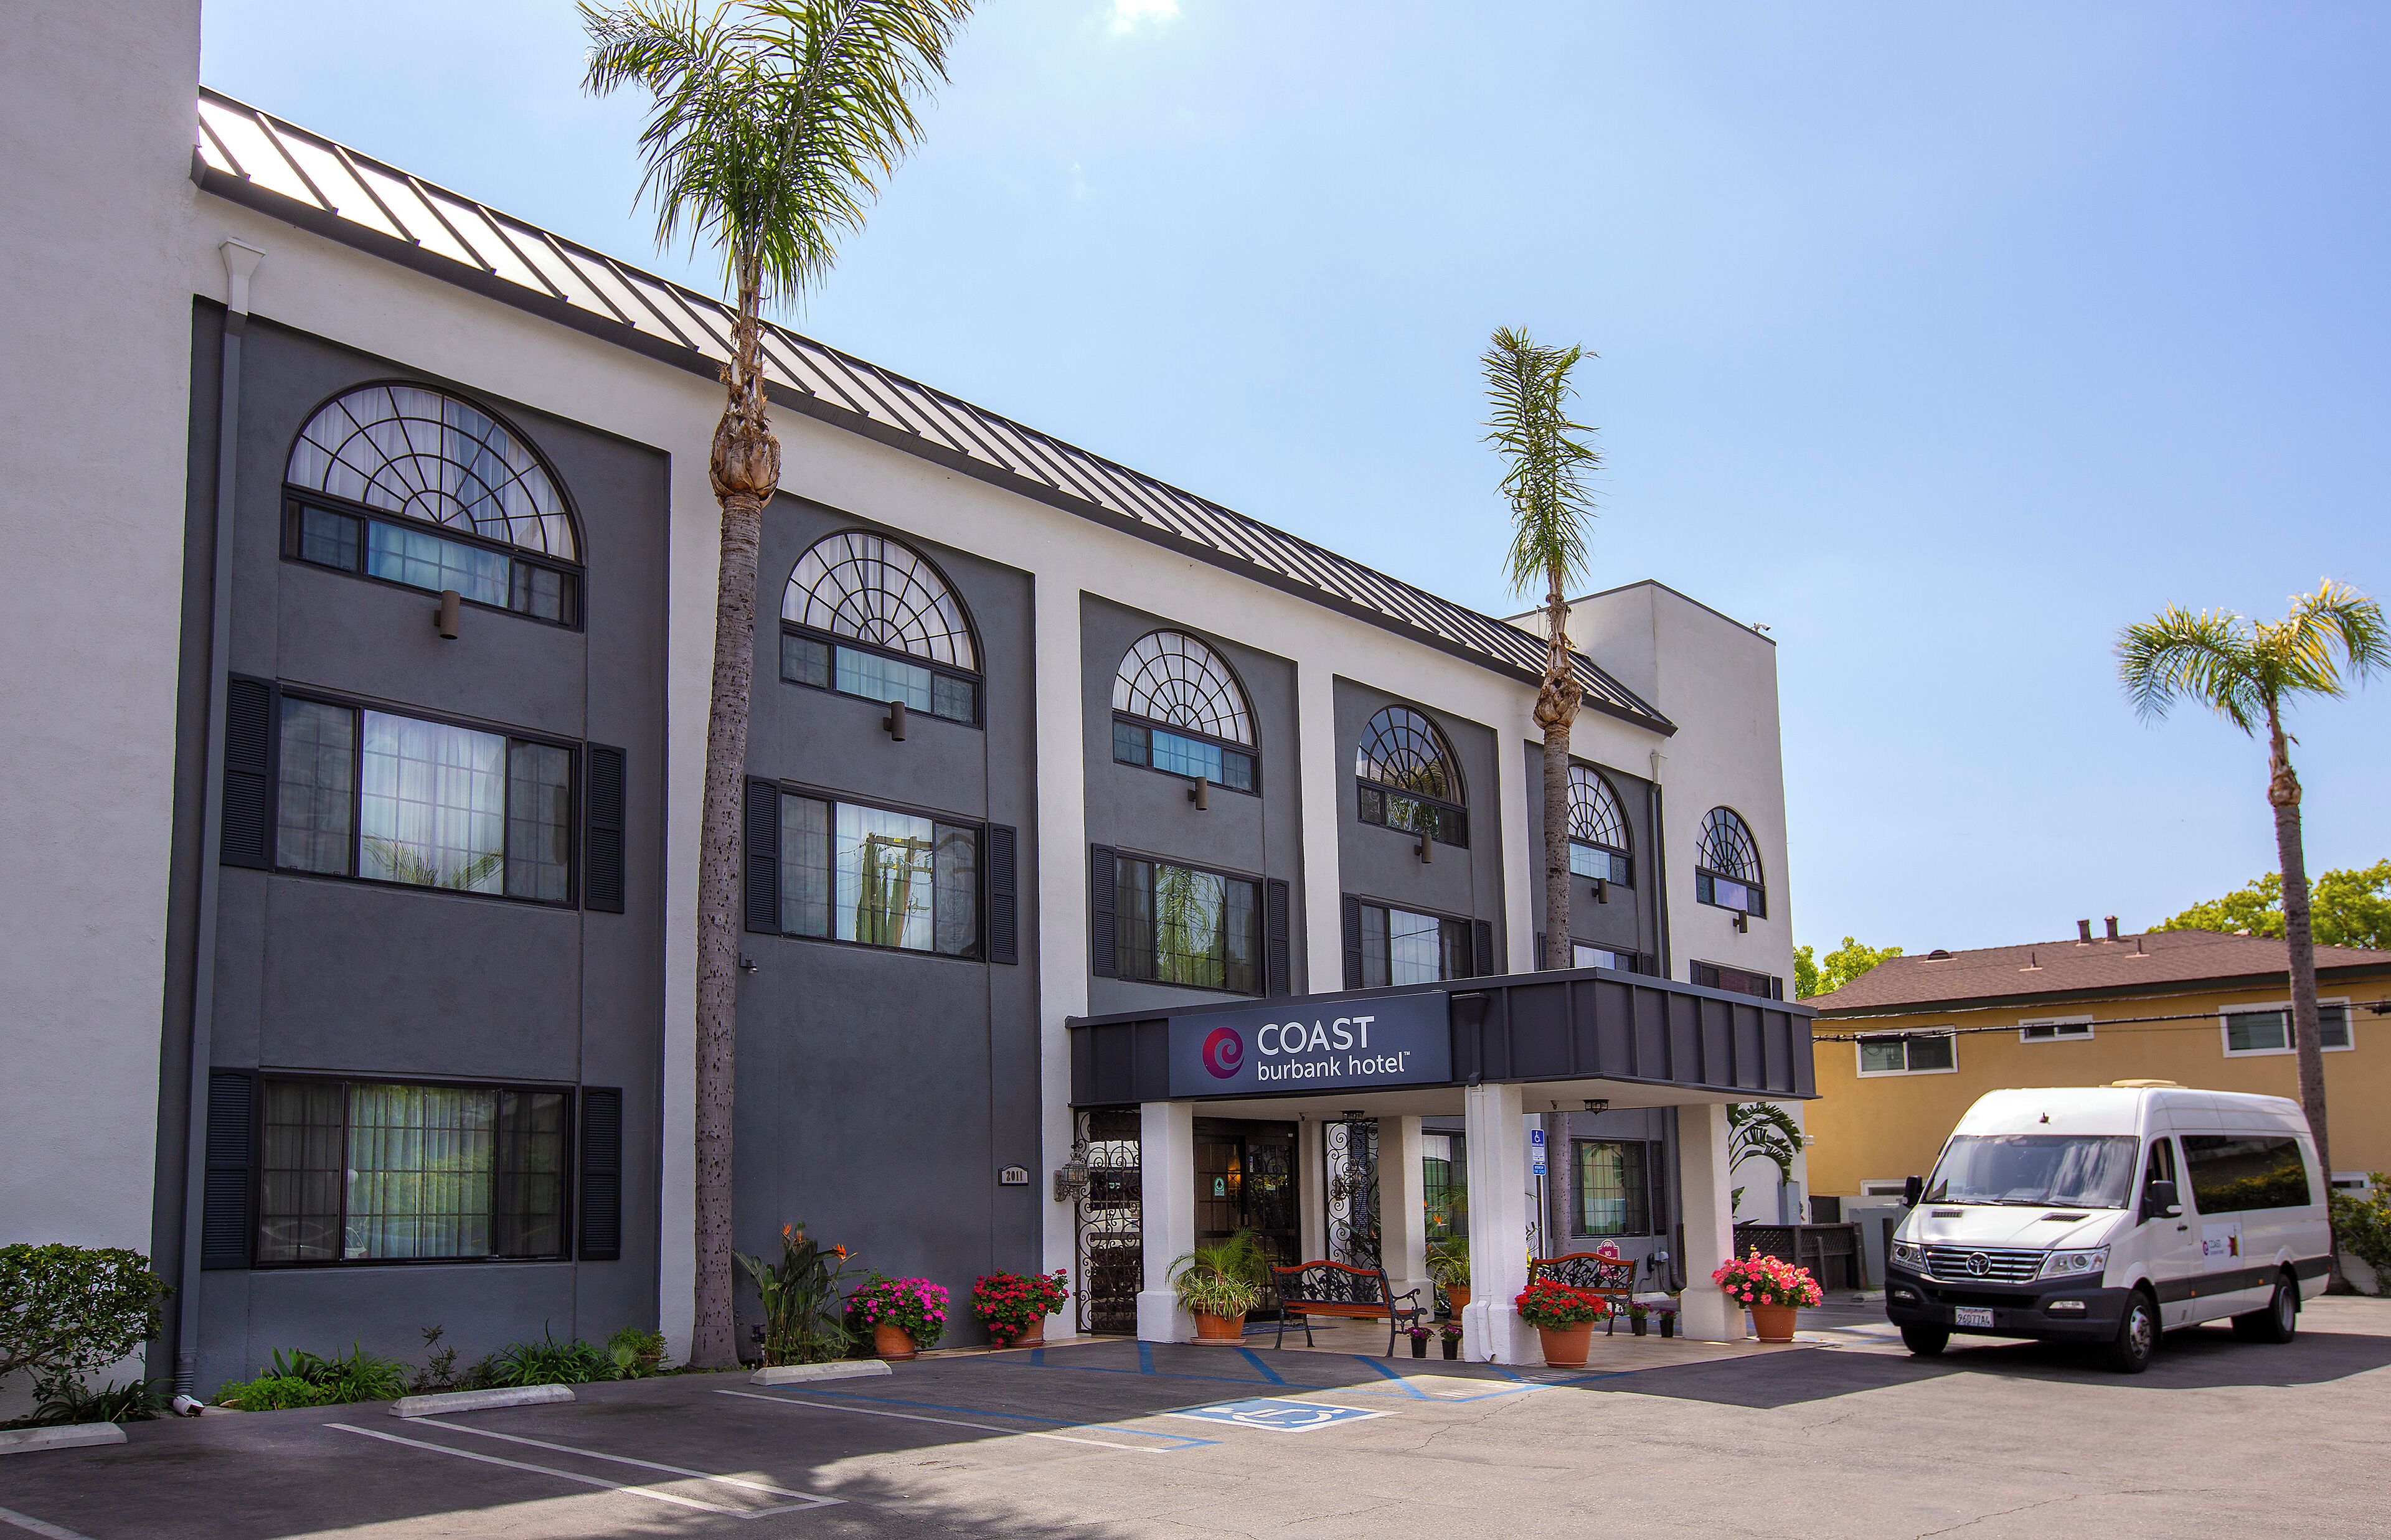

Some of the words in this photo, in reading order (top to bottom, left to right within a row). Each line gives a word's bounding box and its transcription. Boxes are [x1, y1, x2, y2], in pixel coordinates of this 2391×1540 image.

[1257, 1015, 1375, 1055] COAST
[1257, 1056, 1341, 1081] burbank
[1006, 1171, 1023, 1181] 2011
